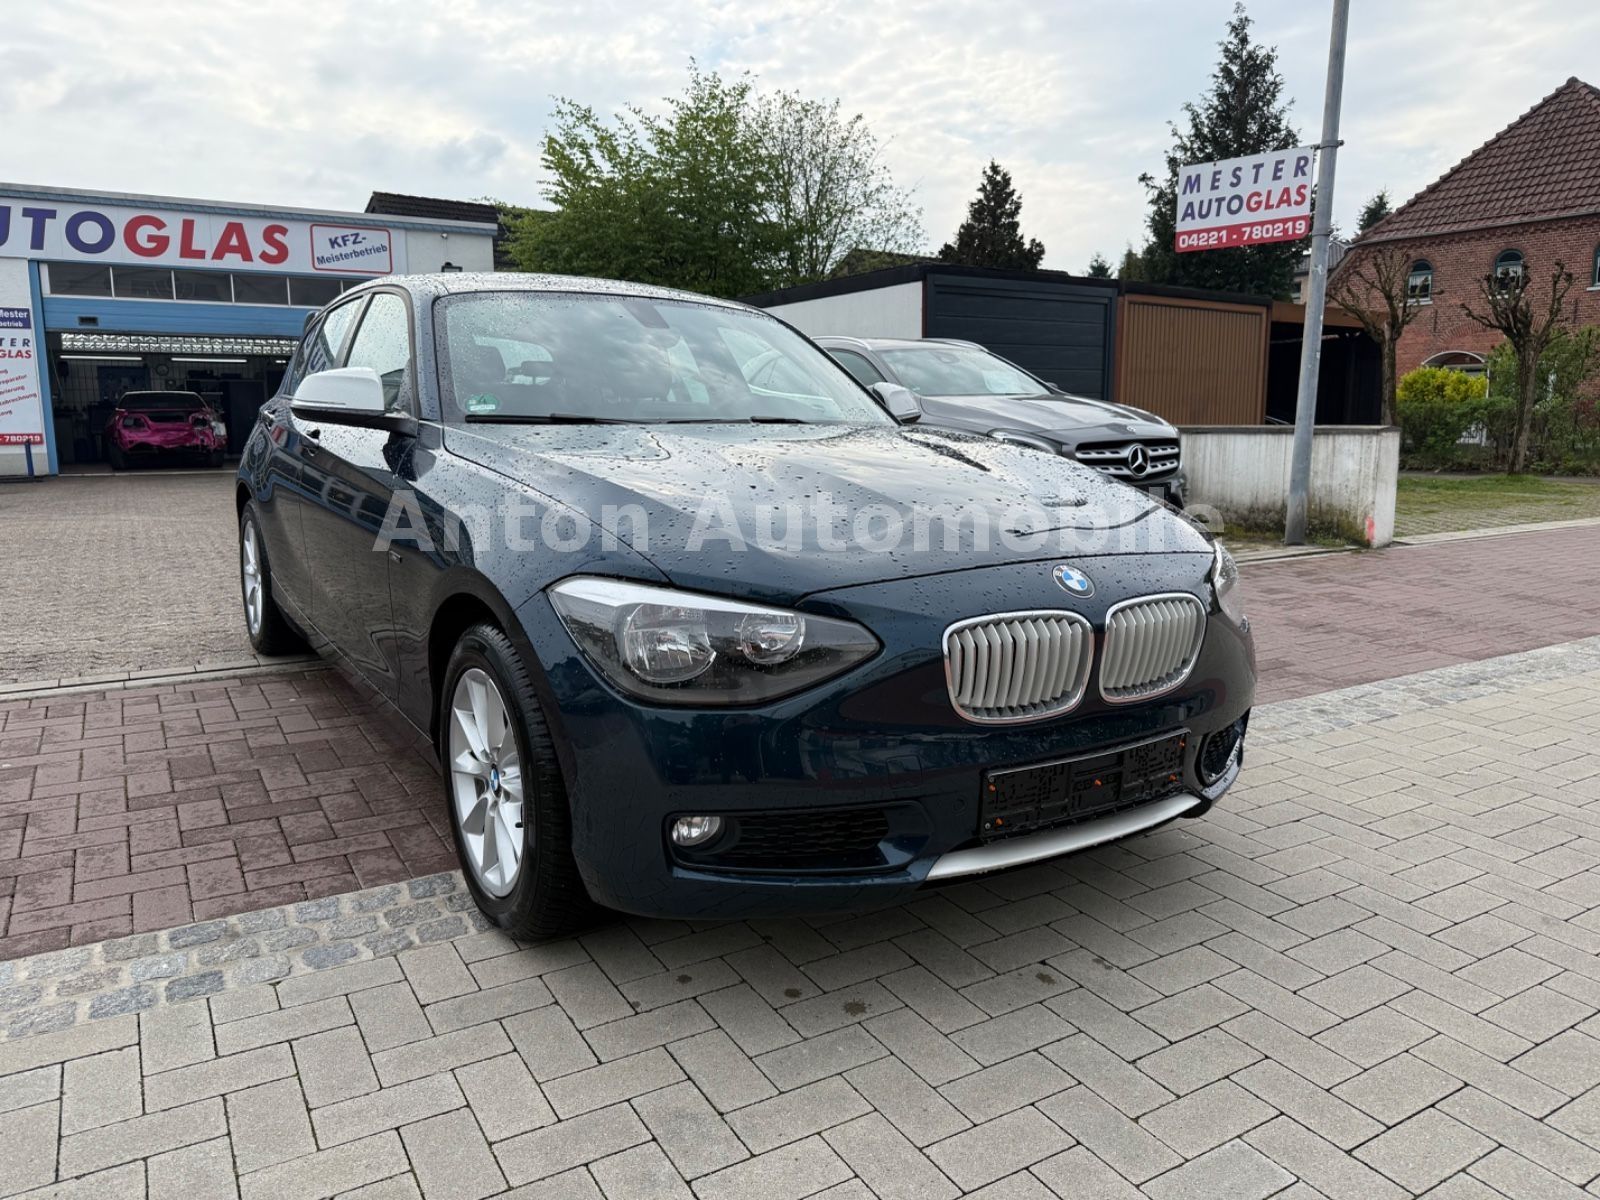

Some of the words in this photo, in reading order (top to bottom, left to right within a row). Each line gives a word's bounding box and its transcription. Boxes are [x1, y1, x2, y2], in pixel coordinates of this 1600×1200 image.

[1182, 156, 1309, 195] MESTER
[1181, 184, 1308, 222] AUTOGLAS
[328, 232, 367, 249] KFZ-
[1179, 230, 1227, 248] 04221
[1241, 220, 1306, 241] 780219
[316, 243, 388, 265] Meisterbetrieb
